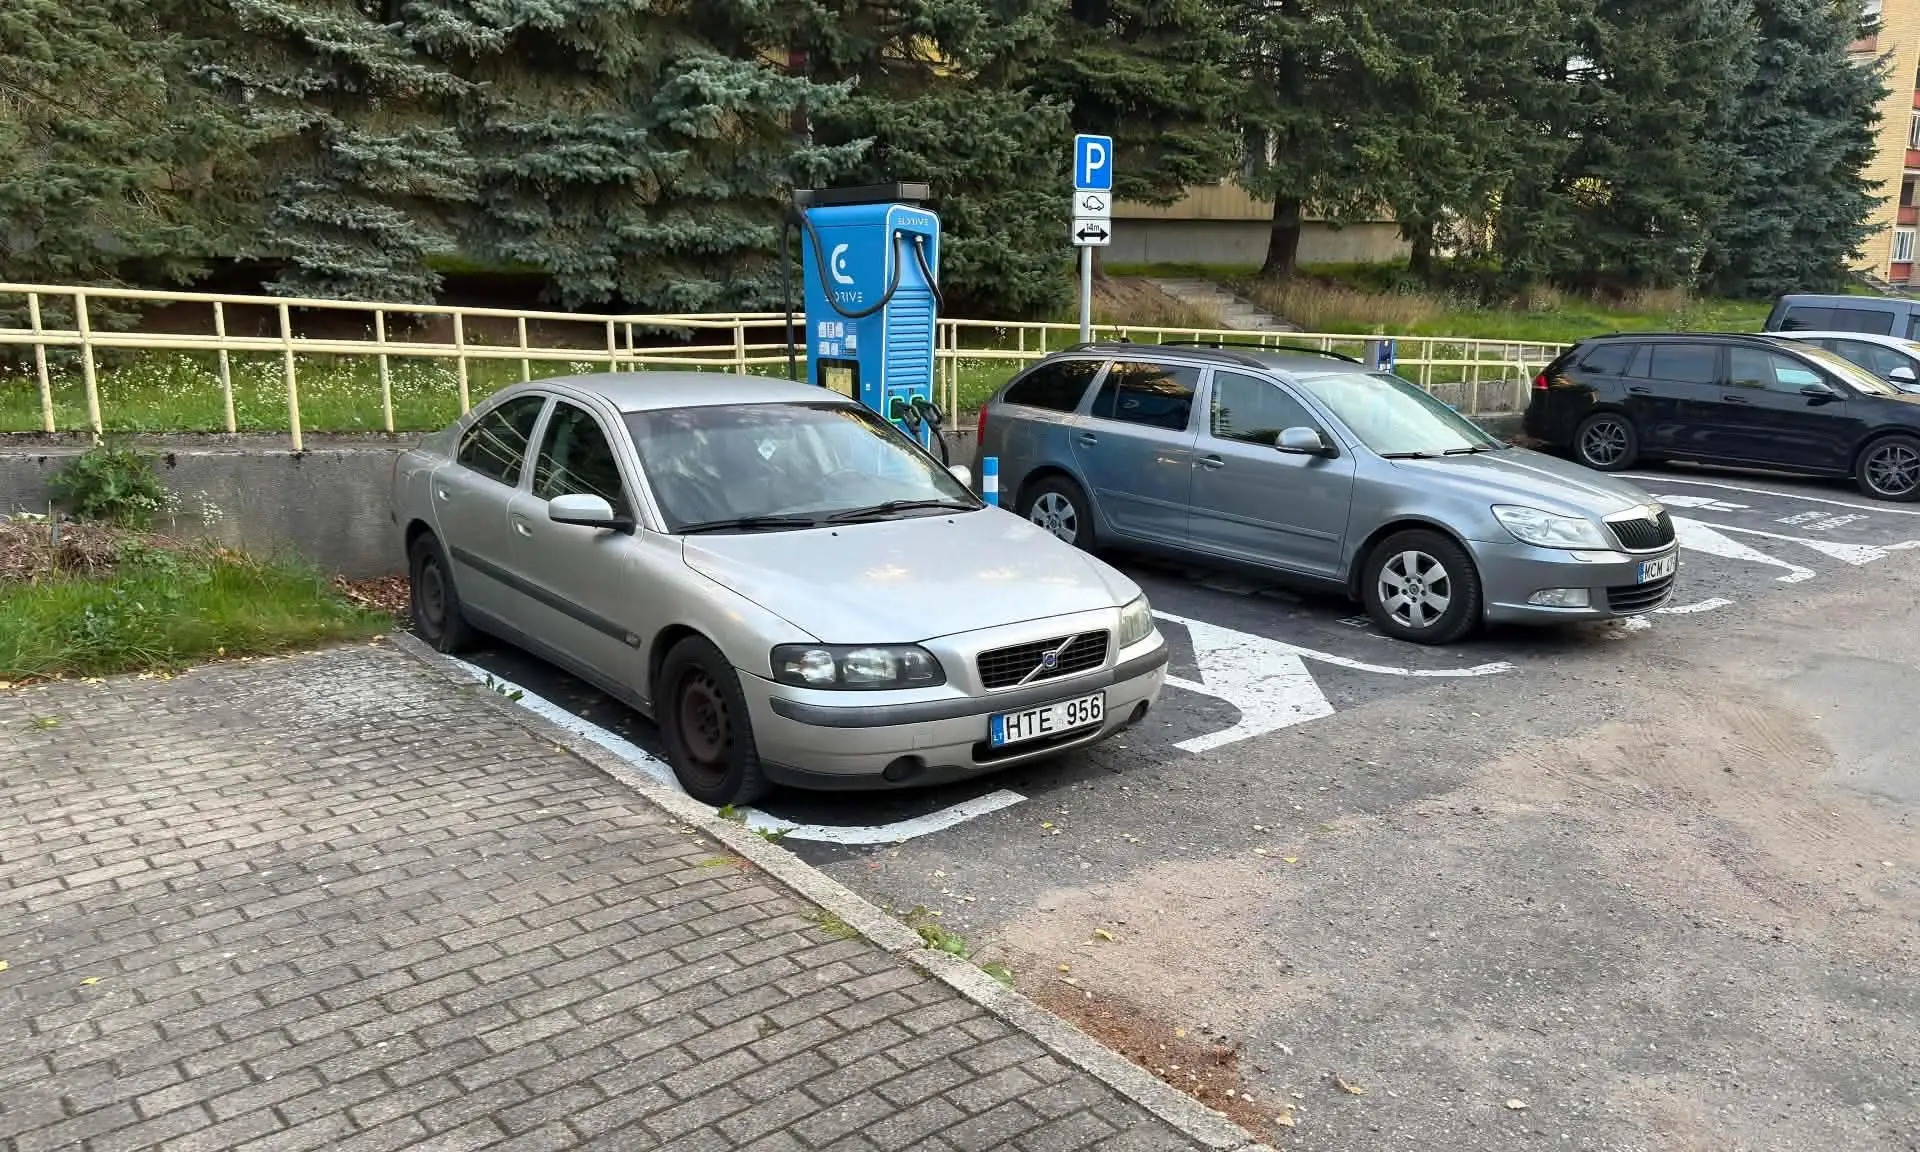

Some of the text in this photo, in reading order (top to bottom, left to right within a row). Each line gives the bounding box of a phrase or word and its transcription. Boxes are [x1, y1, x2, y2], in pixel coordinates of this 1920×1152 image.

[1085, 142, 1106, 184] P
[1086, 223, 1100, 231] 14m
[1006, 708, 1053, 740] HTE
[1067, 696, 1101, 726] 956
